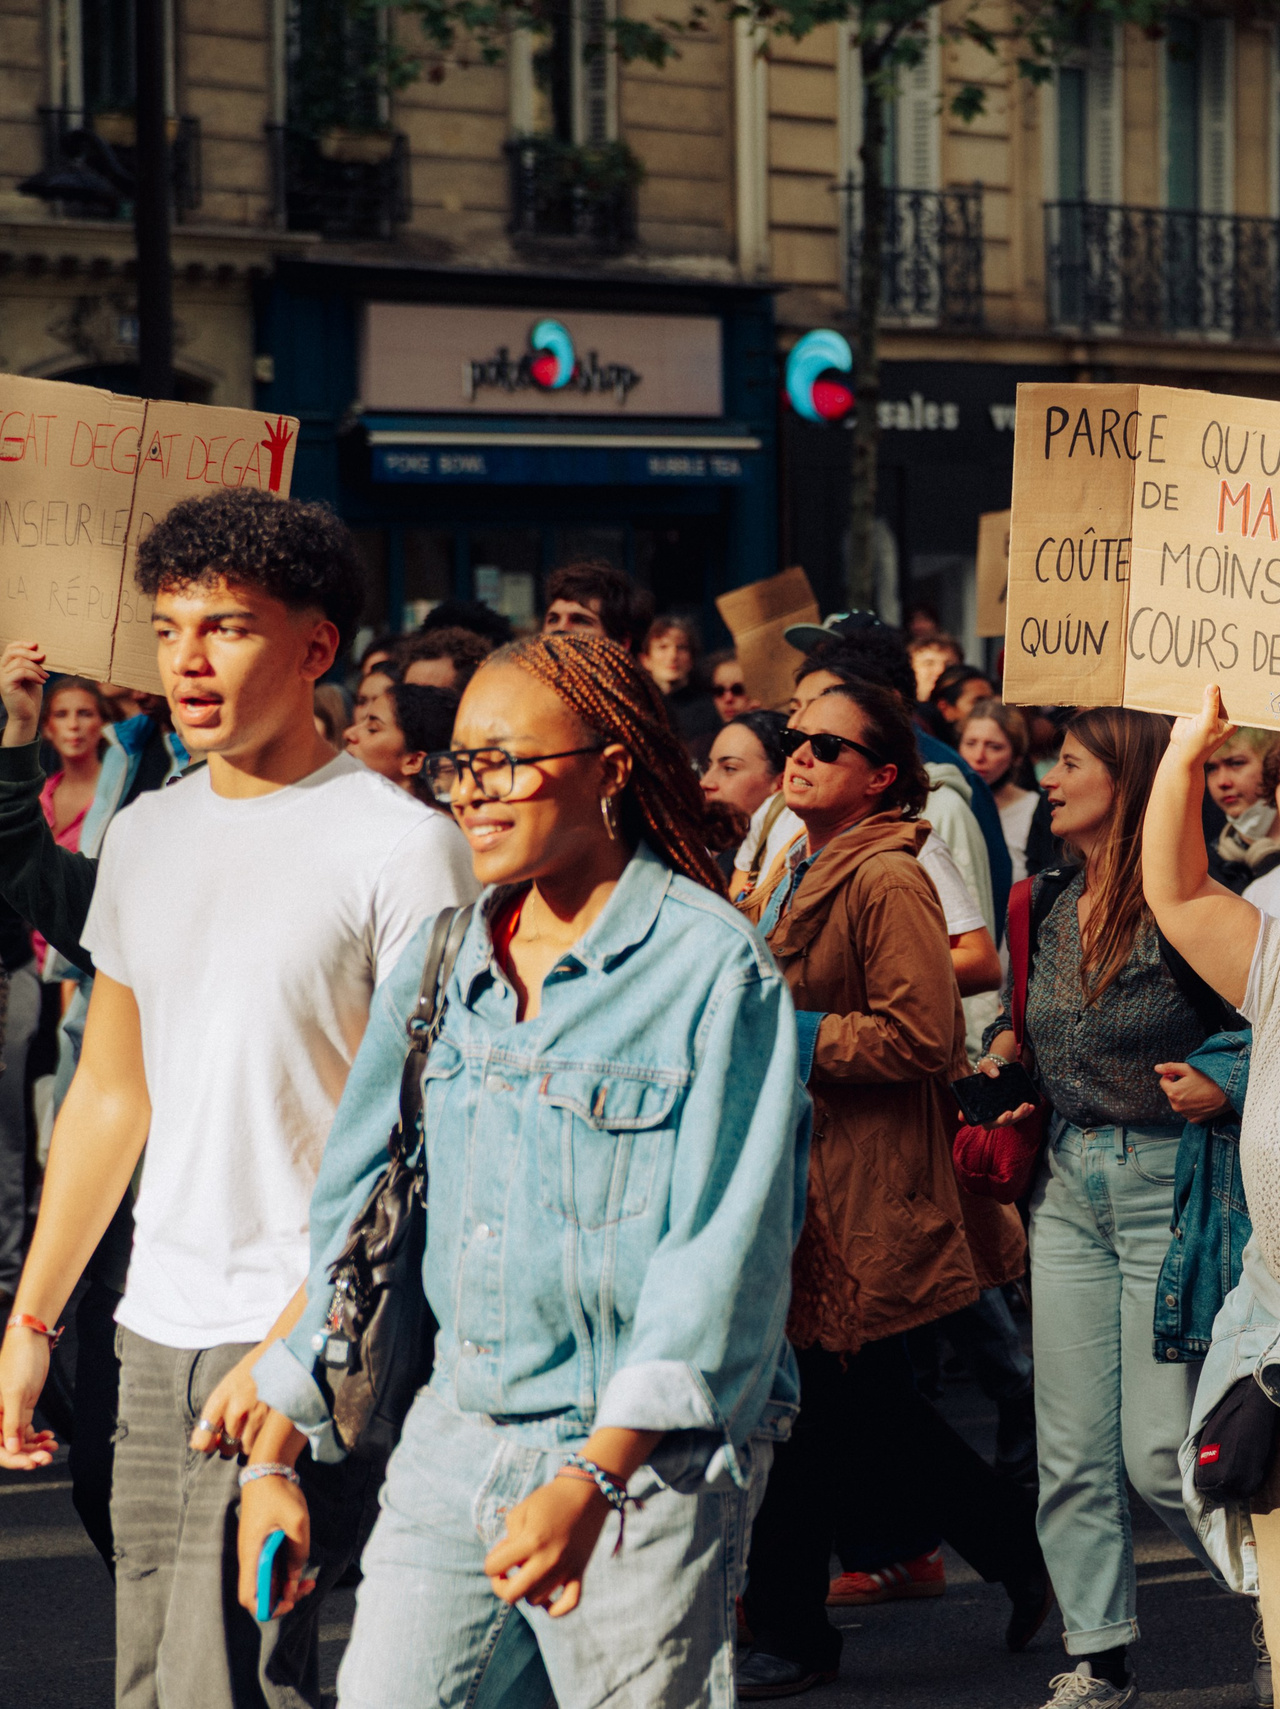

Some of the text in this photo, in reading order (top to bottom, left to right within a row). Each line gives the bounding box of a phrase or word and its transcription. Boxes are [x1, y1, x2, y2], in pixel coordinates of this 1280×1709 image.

[0, 411, 58, 467] GAT
[1044, 405, 1169, 464] PARCE
[439, 454, 487, 475] BOWL
[648, 455, 743, 477] BUBBLE TEA
[1141, 480, 1179, 511] DE
[0, 500, 92, 548] NSIEUR
[101, 508, 131, 547] LE
[1034, 526, 1132, 584] COÛTE
[7, 575, 155, 624] LA RÉPUBL
[1020, 612, 1109, 658] QU'UN
[1128, 606, 1239, 673] COURS
